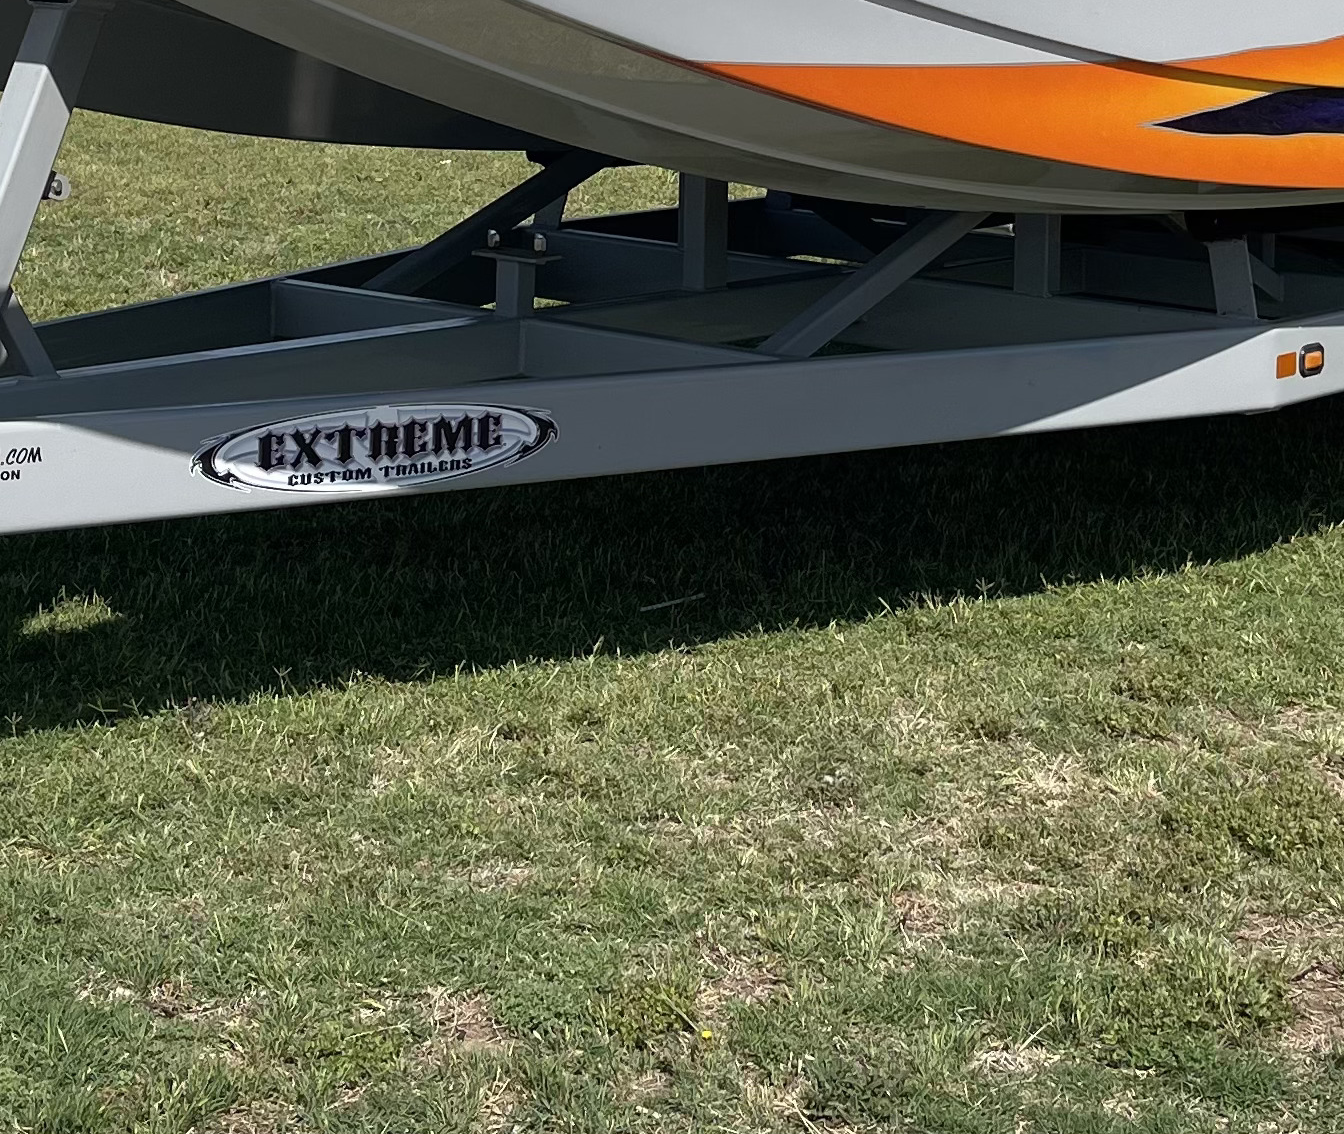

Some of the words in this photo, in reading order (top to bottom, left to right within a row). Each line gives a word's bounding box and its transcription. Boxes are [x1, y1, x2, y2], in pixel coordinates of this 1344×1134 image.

[256, 411, 507, 472] EXTREME
[287, 468, 372, 487] CUSTOM
[380, 458, 473, 478] TRAILERS
